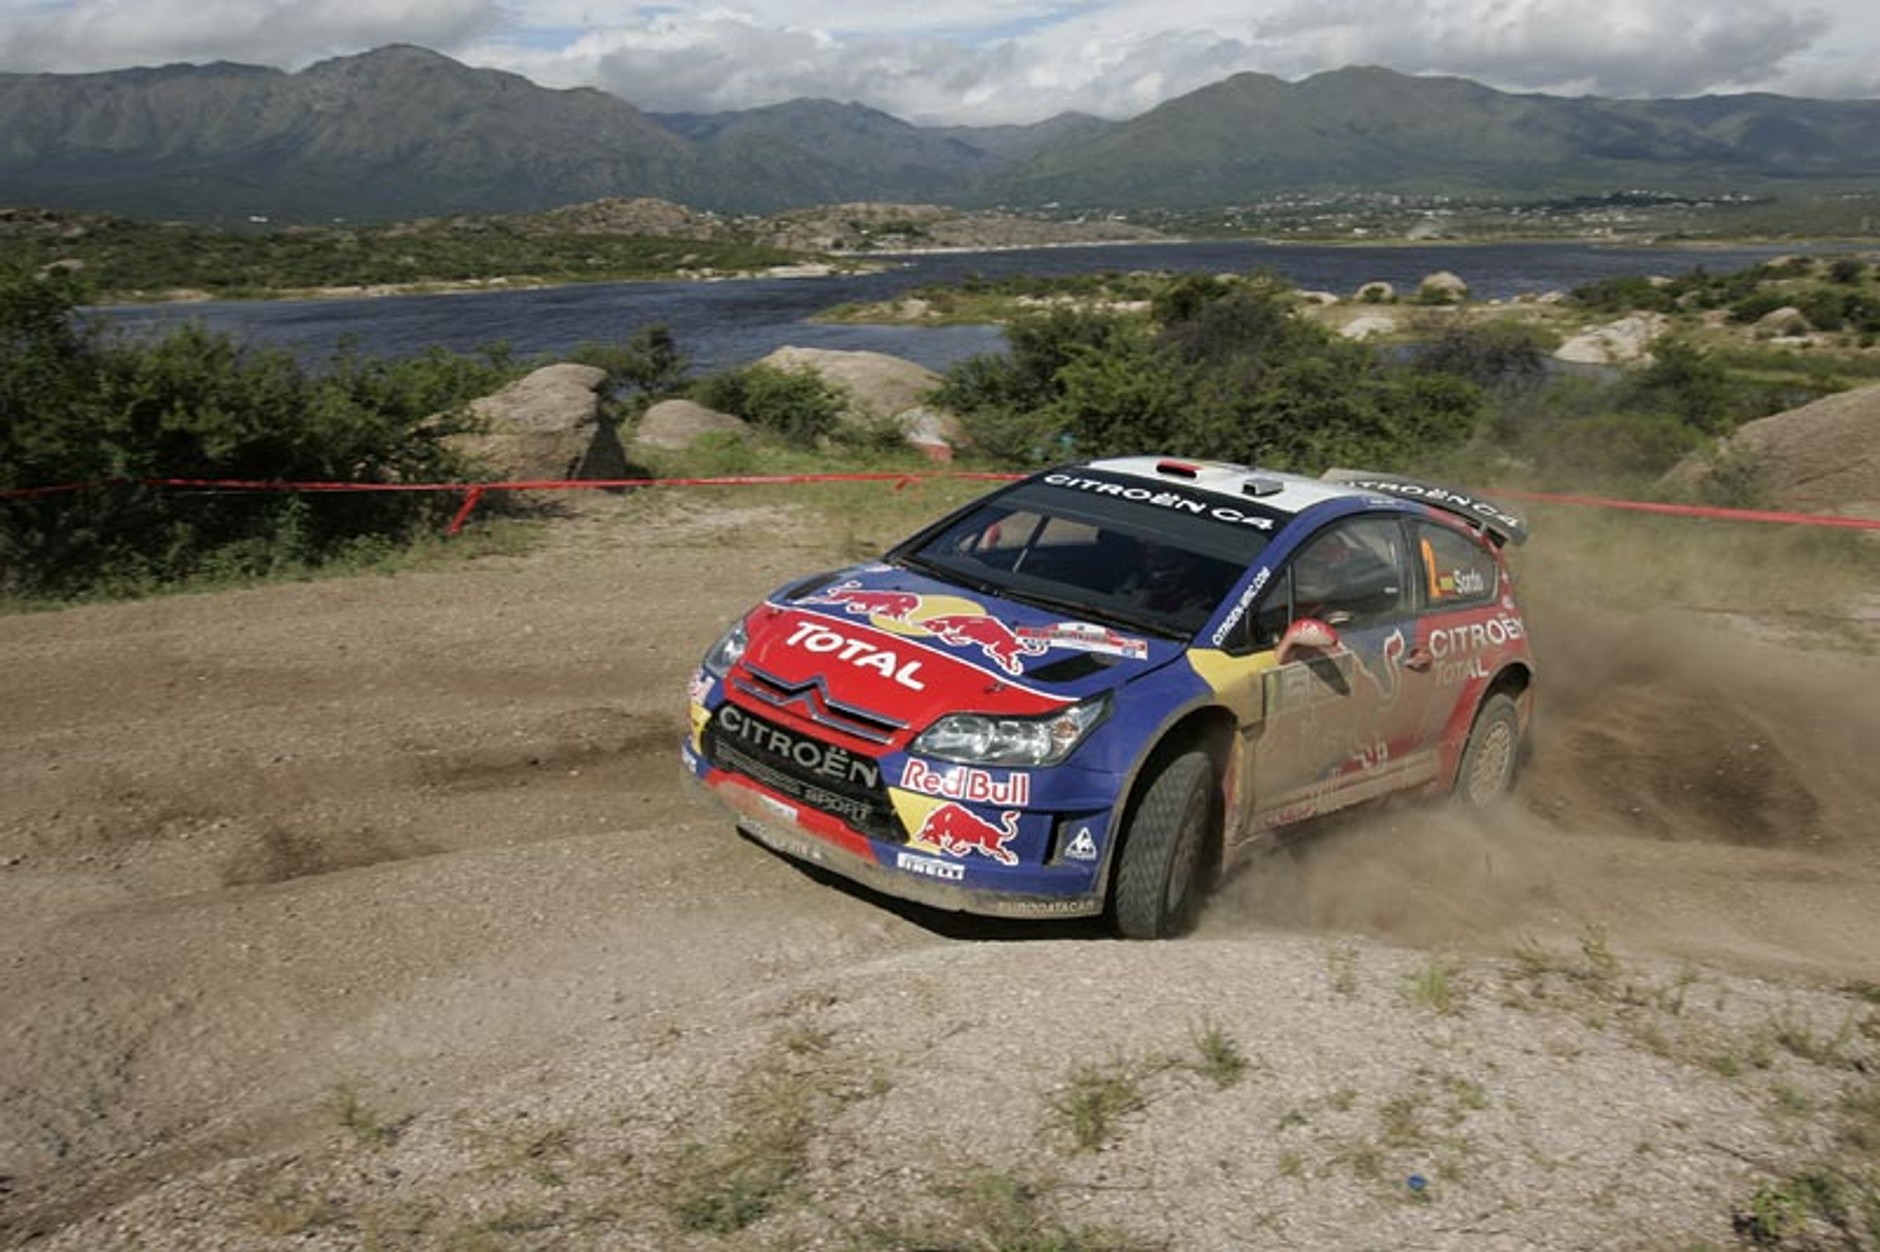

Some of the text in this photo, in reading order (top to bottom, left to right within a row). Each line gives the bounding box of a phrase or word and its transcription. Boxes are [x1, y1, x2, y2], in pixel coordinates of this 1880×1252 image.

[1043, 473, 1276, 531] CITROËN C4
[1473, 503, 1520, 528] C4
[787, 621, 925, 691] TOTAL
[719, 705, 878, 788] CITROËN
[901, 757, 1030, 807] Red Bull
[898, 852, 964, 880] PIRELLI
